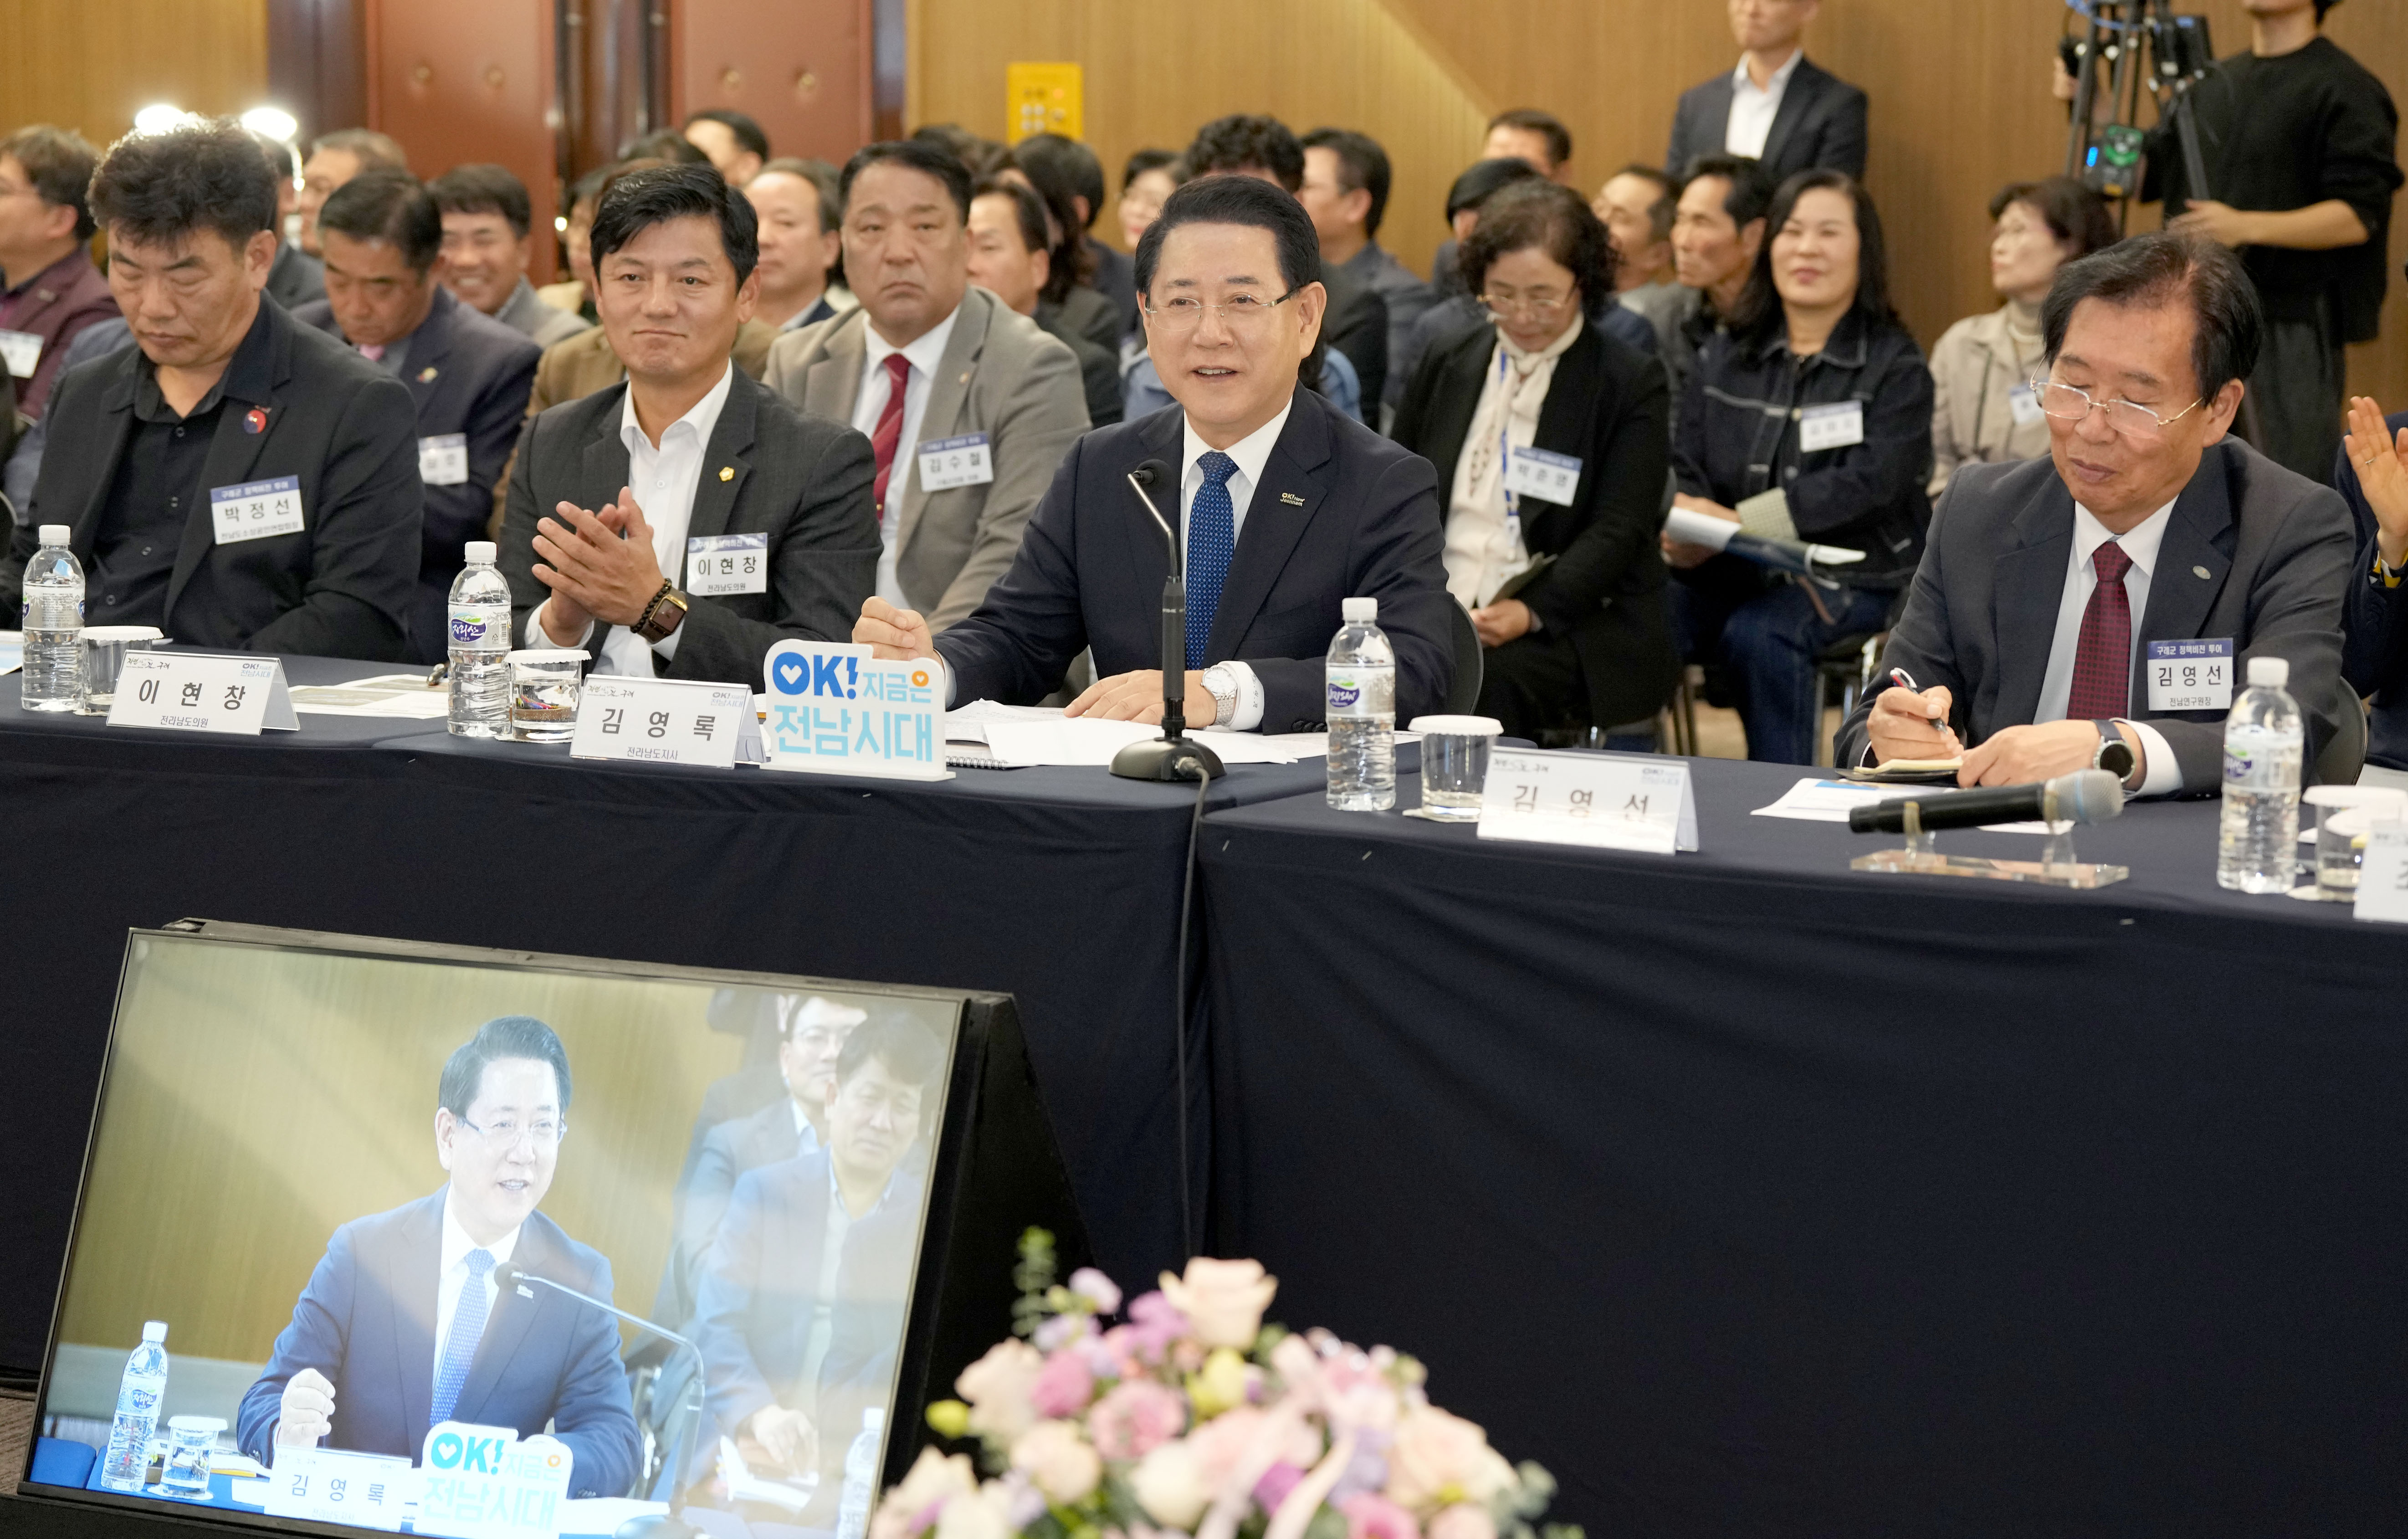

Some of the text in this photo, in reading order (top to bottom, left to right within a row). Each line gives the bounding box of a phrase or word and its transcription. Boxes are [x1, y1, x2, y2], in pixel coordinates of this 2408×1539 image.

[1280, 498, 1302, 507] Jeonnam
[707, 583, 746, 592] 전라남도의원
[452, 624, 484, 636] 지리산
[2157, 644, 2222, 655] 구례군 정책비전 투어
[772, 652, 932, 703] OK! 지금은
[2170, 697, 2211, 706] 전남연구원장
[160, 715, 208, 728] 전라남도의원
[774, 705, 932, 762] 전남시대
[627, 747, 678, 760] 전라남도지사
[431, 1433, 505, 1475] OK!
[424, 1477, 557, 1531] 전남시대
